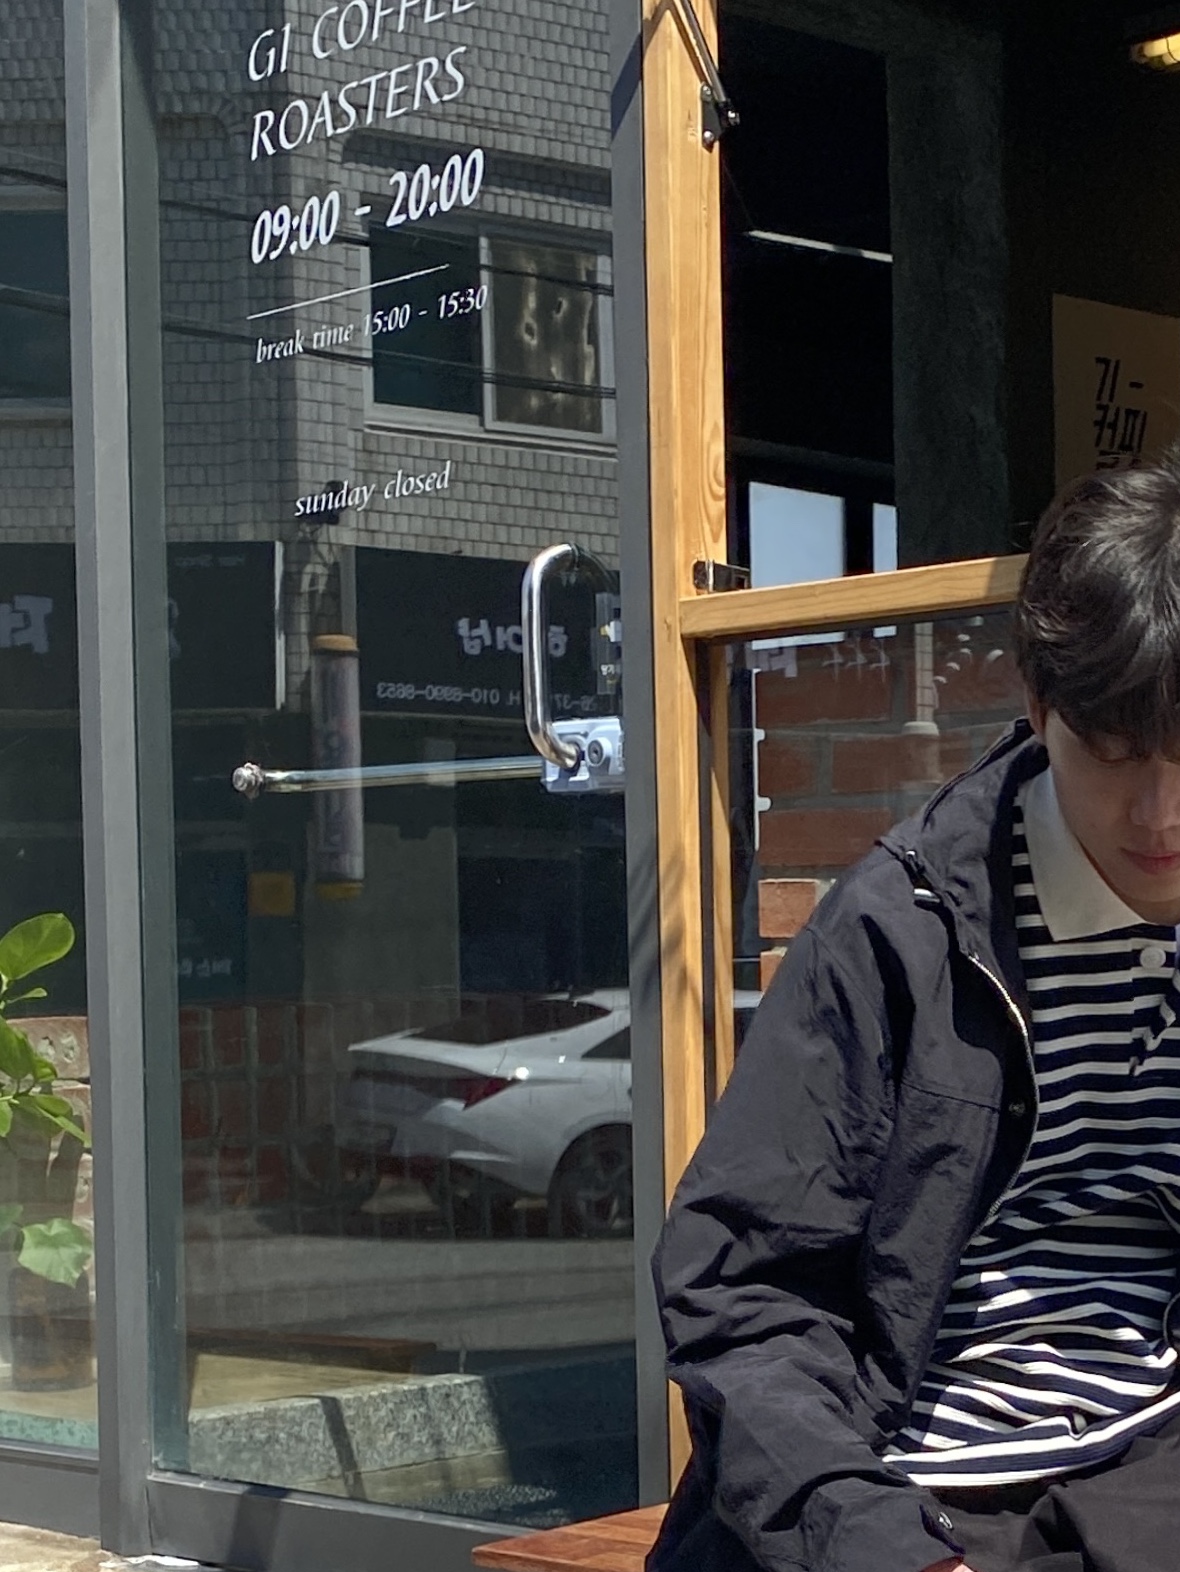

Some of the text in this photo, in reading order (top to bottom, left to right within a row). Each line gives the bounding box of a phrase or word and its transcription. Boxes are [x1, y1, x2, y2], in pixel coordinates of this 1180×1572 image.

[312, 0, 476, 59] COFF
[250, 46, 467, 161] ROASTERS
[251, 190, 340, 264] 09:00
[385, 148, 484, 227] 20:00
[256, 329, 304, 364] break
[312, 323, 353, 350] time
[363, 303, 410, 337] 15:00
[438, 285, 488, 319] 15:30
[294, 460, 452, 516] sunday closed
